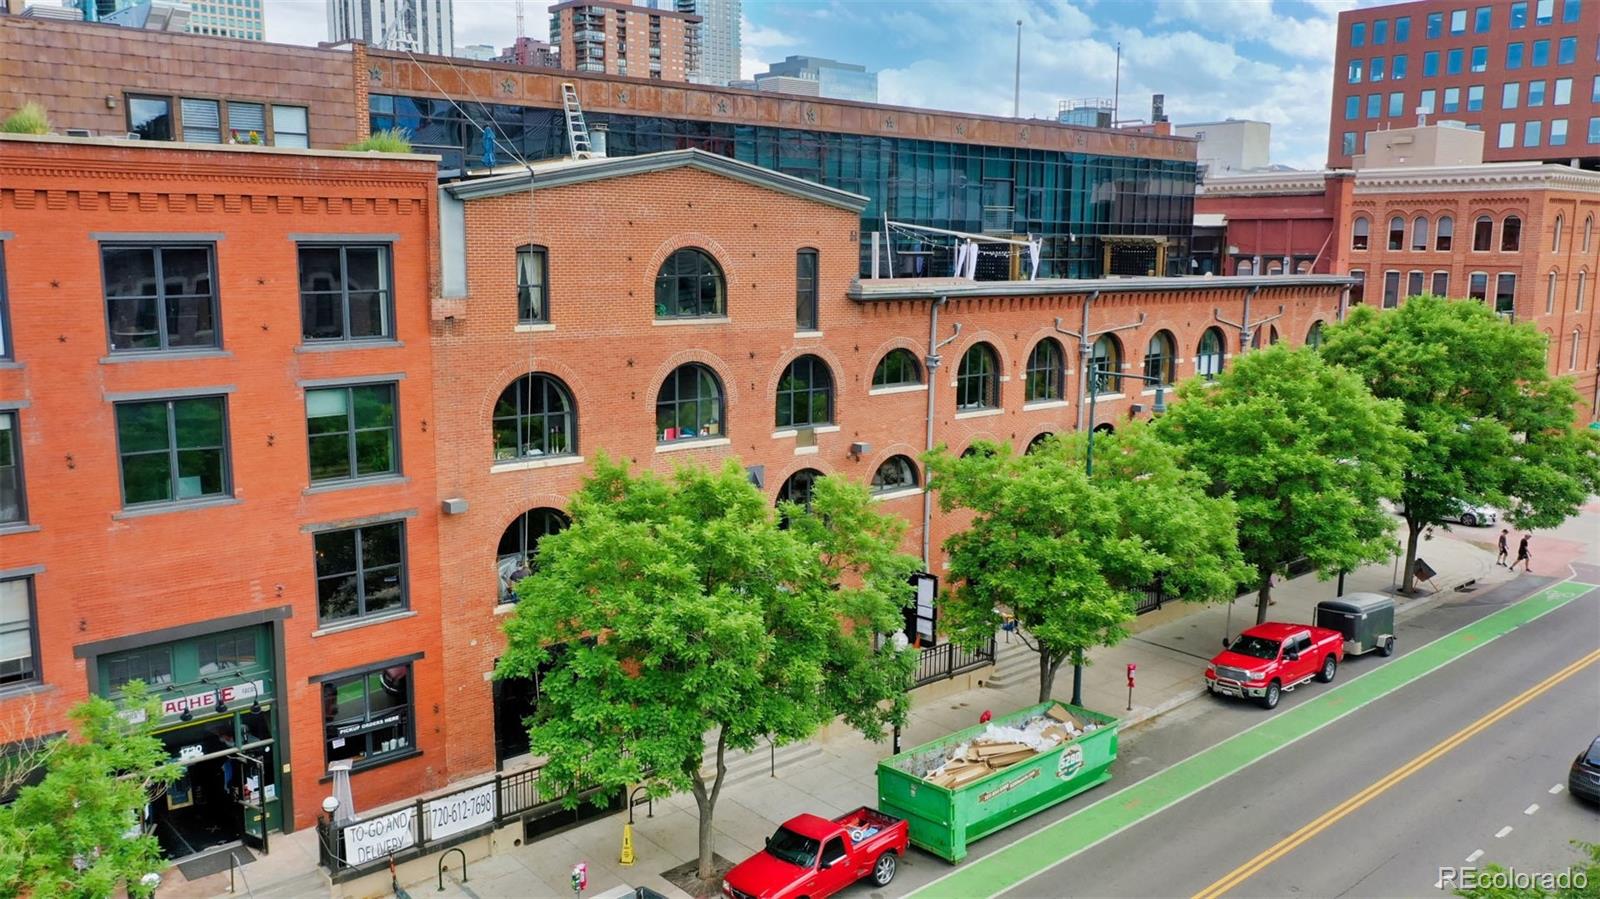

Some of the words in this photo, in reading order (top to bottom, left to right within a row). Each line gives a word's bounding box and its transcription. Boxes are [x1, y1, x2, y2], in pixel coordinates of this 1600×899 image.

[156, 687, 235, 715] ACHEE
[340, 724, 360, 734] PICKUP
[361, 719, 384, 729] ORDERS
[384, 715, 399, 723] HERE
[432, 792, 491, 829] 720-612-7698
[350, 820, 385, 843] TO-GO
[386, 812, 409, 834] AND
[358, 835, 405, 864] DELIVERY
